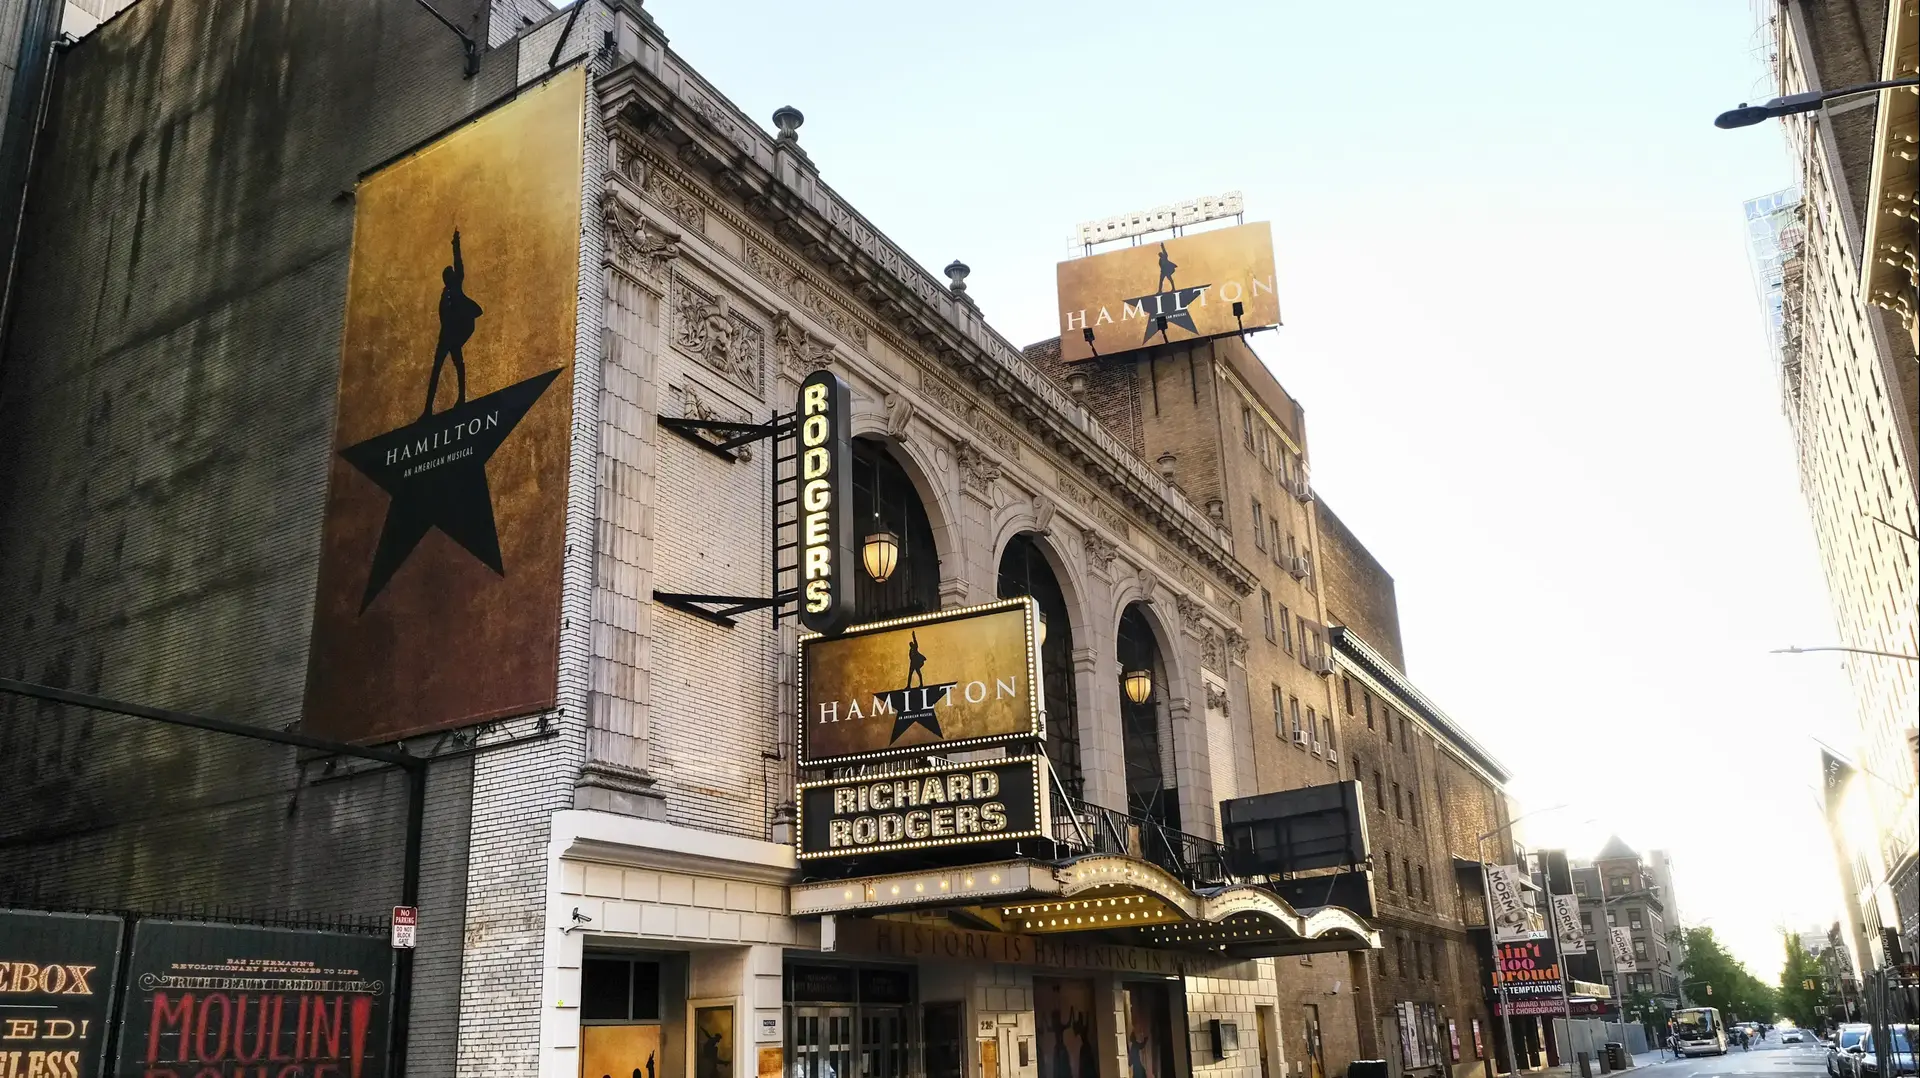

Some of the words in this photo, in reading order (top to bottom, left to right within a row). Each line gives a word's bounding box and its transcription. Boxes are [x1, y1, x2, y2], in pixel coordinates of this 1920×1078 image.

[1067, 275, 1273, 331] HAMILTON
[386, 411, 499, 466] HAMILTON
[403, 468, 412, 478] AN
[414, 456, 445, 474] AMERICAN
[447, 446, 473, 463] MUSICAL
[803, 383, 831, 614] RODGERS
[819, 676, 1017, 724] HAMILTON
[834, 770, 999, 815] RICHARD
[829, 802, 1007, 847] RODGERS
[171, 963, 259, 972] REVOLUTIONARY
[877, 923, 989, 959] HISTORY
[1003, 936, 1022, 962] IS
[1034, 936, 1138, 970] HAPPENING
[1144, 951, 1161, 971] IN
[169, 976, 210, 988] TRUTH
[222, 978, 267, 990] BEAUTY
[1491, 964, 1560, 986] proud
[1493, 987, 1508, 995] TE
[1510, 985, 1562, 995] TEMPTATIONS
[2, 1019, 90, 1039] ED!
